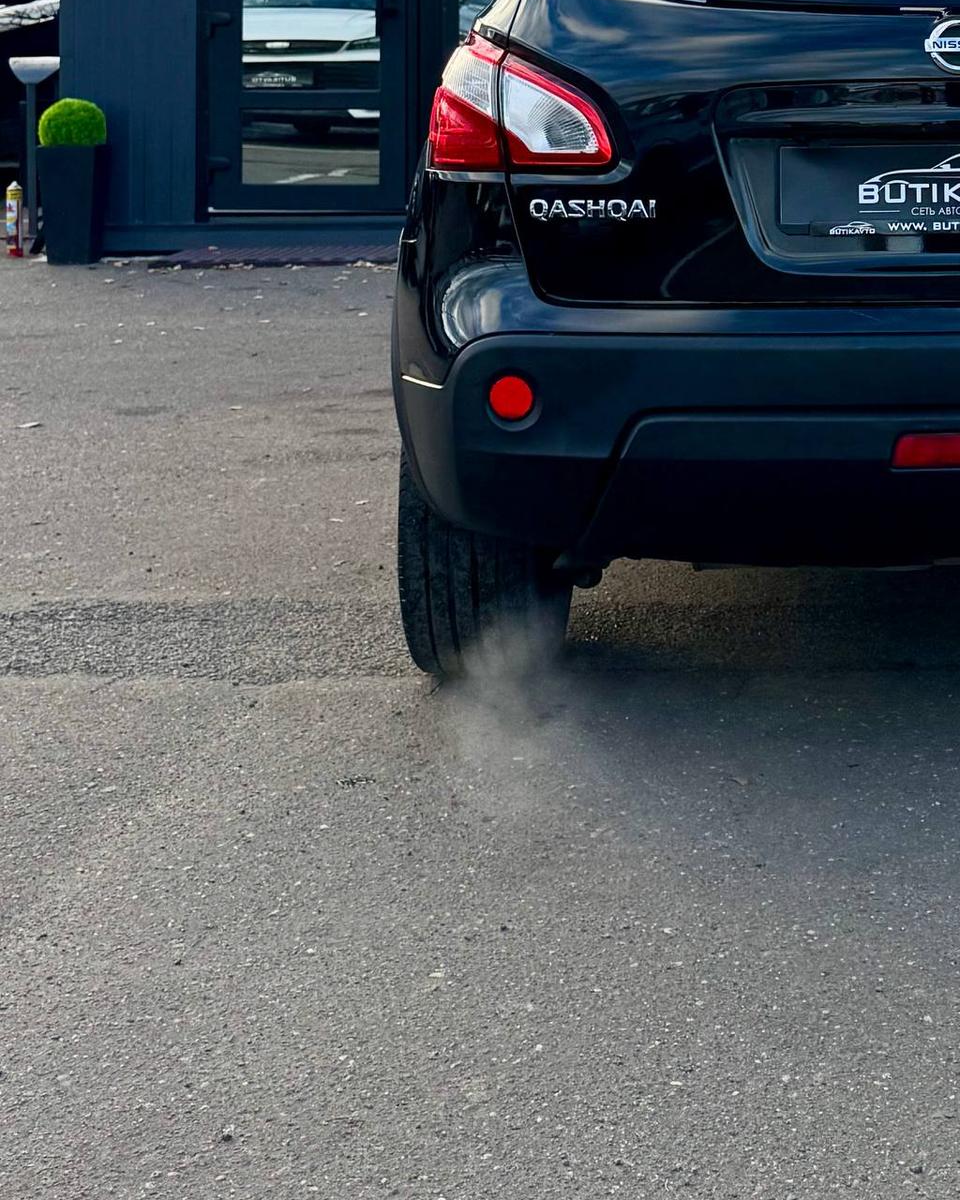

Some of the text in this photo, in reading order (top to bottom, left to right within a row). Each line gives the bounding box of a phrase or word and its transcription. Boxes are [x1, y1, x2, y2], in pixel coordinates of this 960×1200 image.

[529, 199, 657, 221] QASHQAI
[911, 206, 936, 216] СЕТЬ
[888, 222, 927, 231] WWW.
